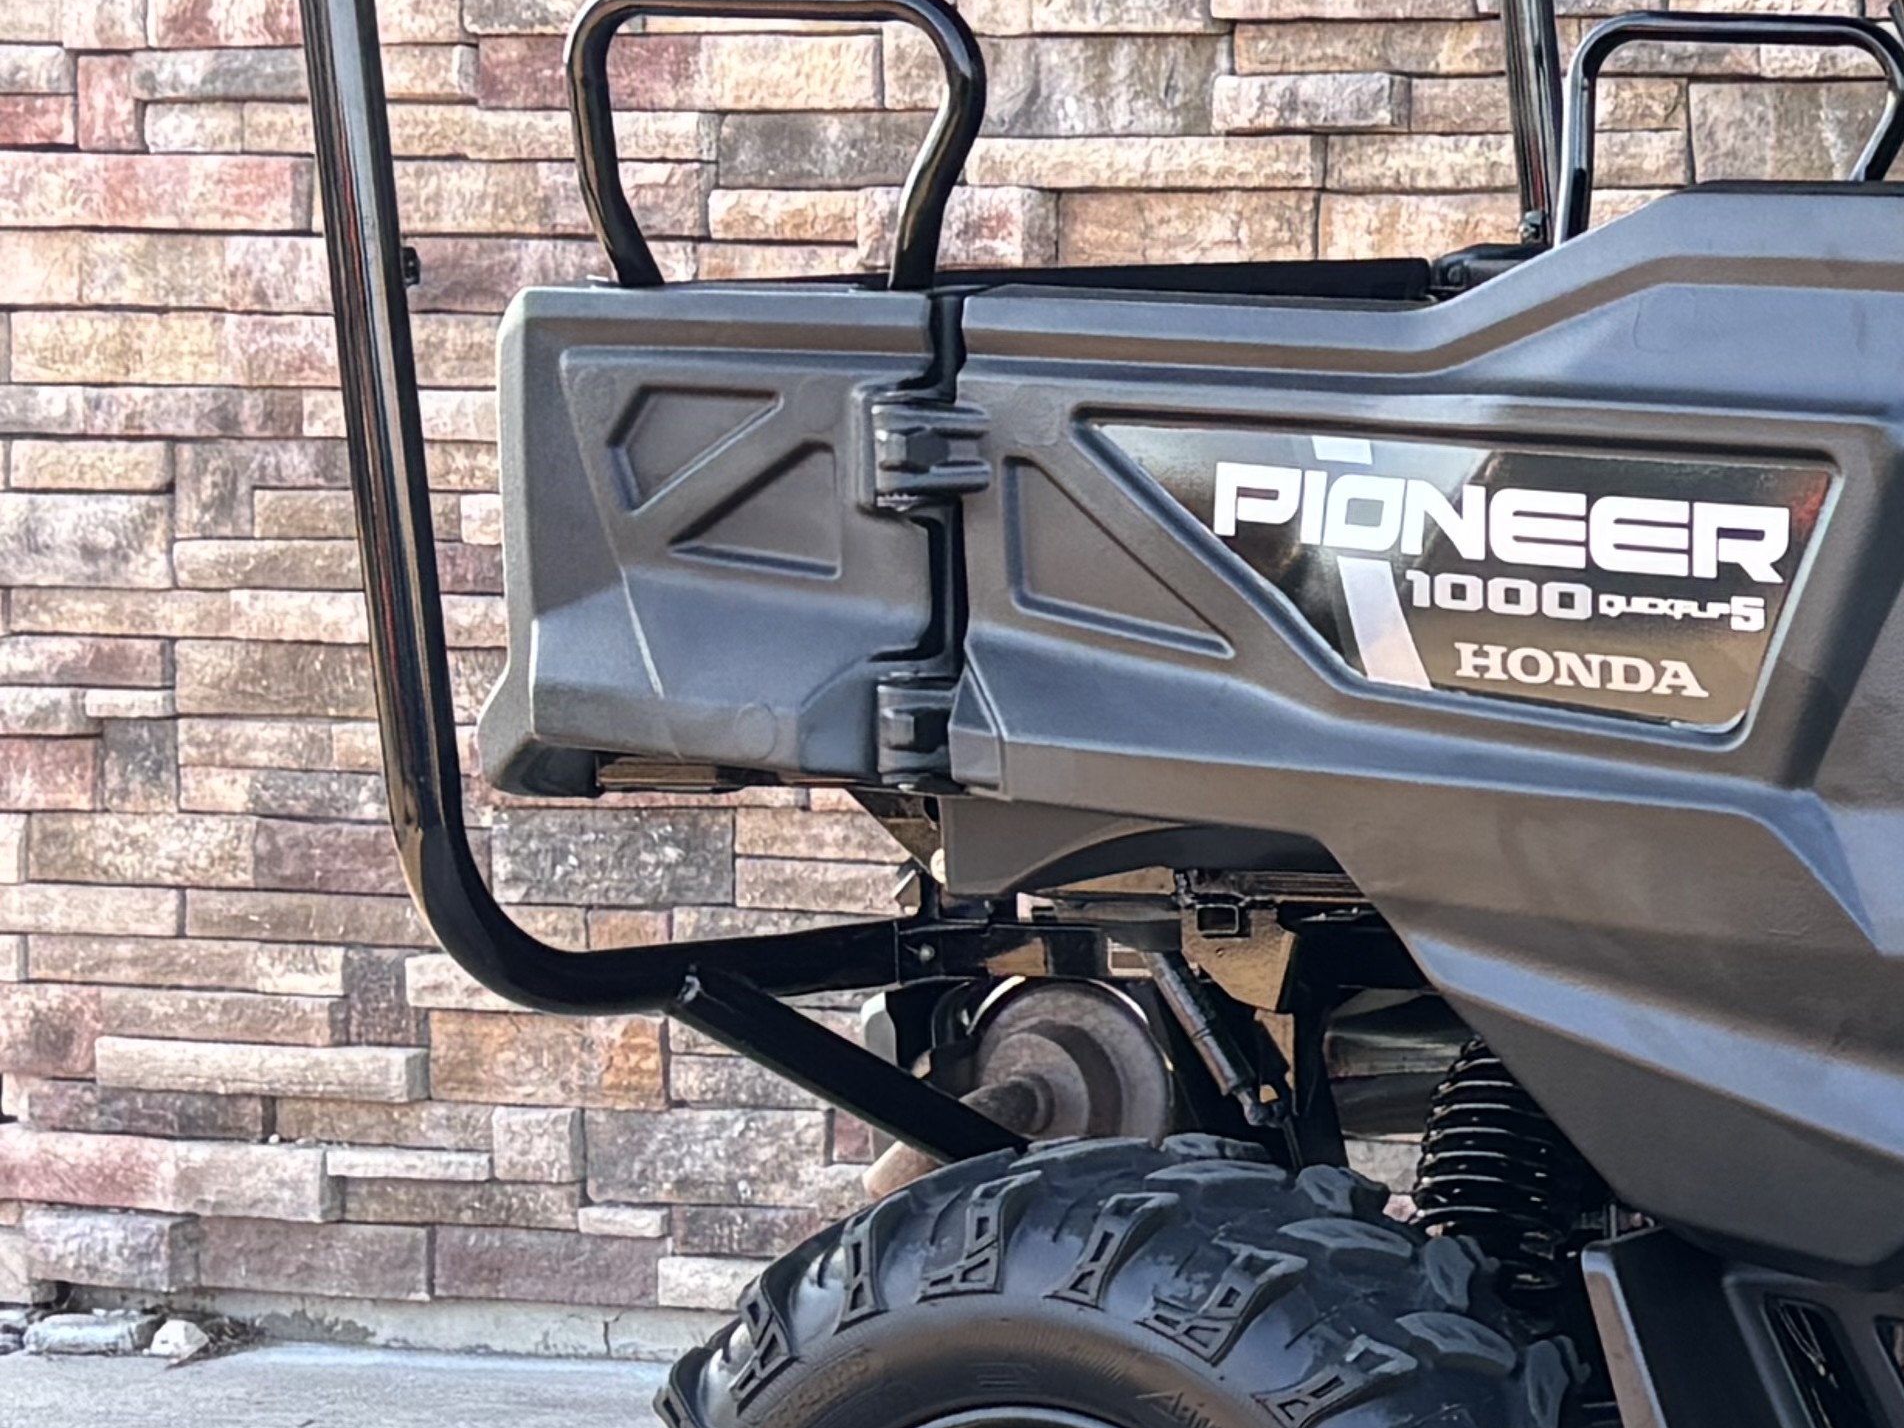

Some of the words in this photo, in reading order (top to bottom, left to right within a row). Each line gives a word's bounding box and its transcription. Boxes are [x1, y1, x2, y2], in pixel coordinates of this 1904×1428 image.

[1211, 461, 1792, 585] PIONEER
[1407, 568, 1592, 620] 1000
[1453, 641, 1710, 699] HONDA
